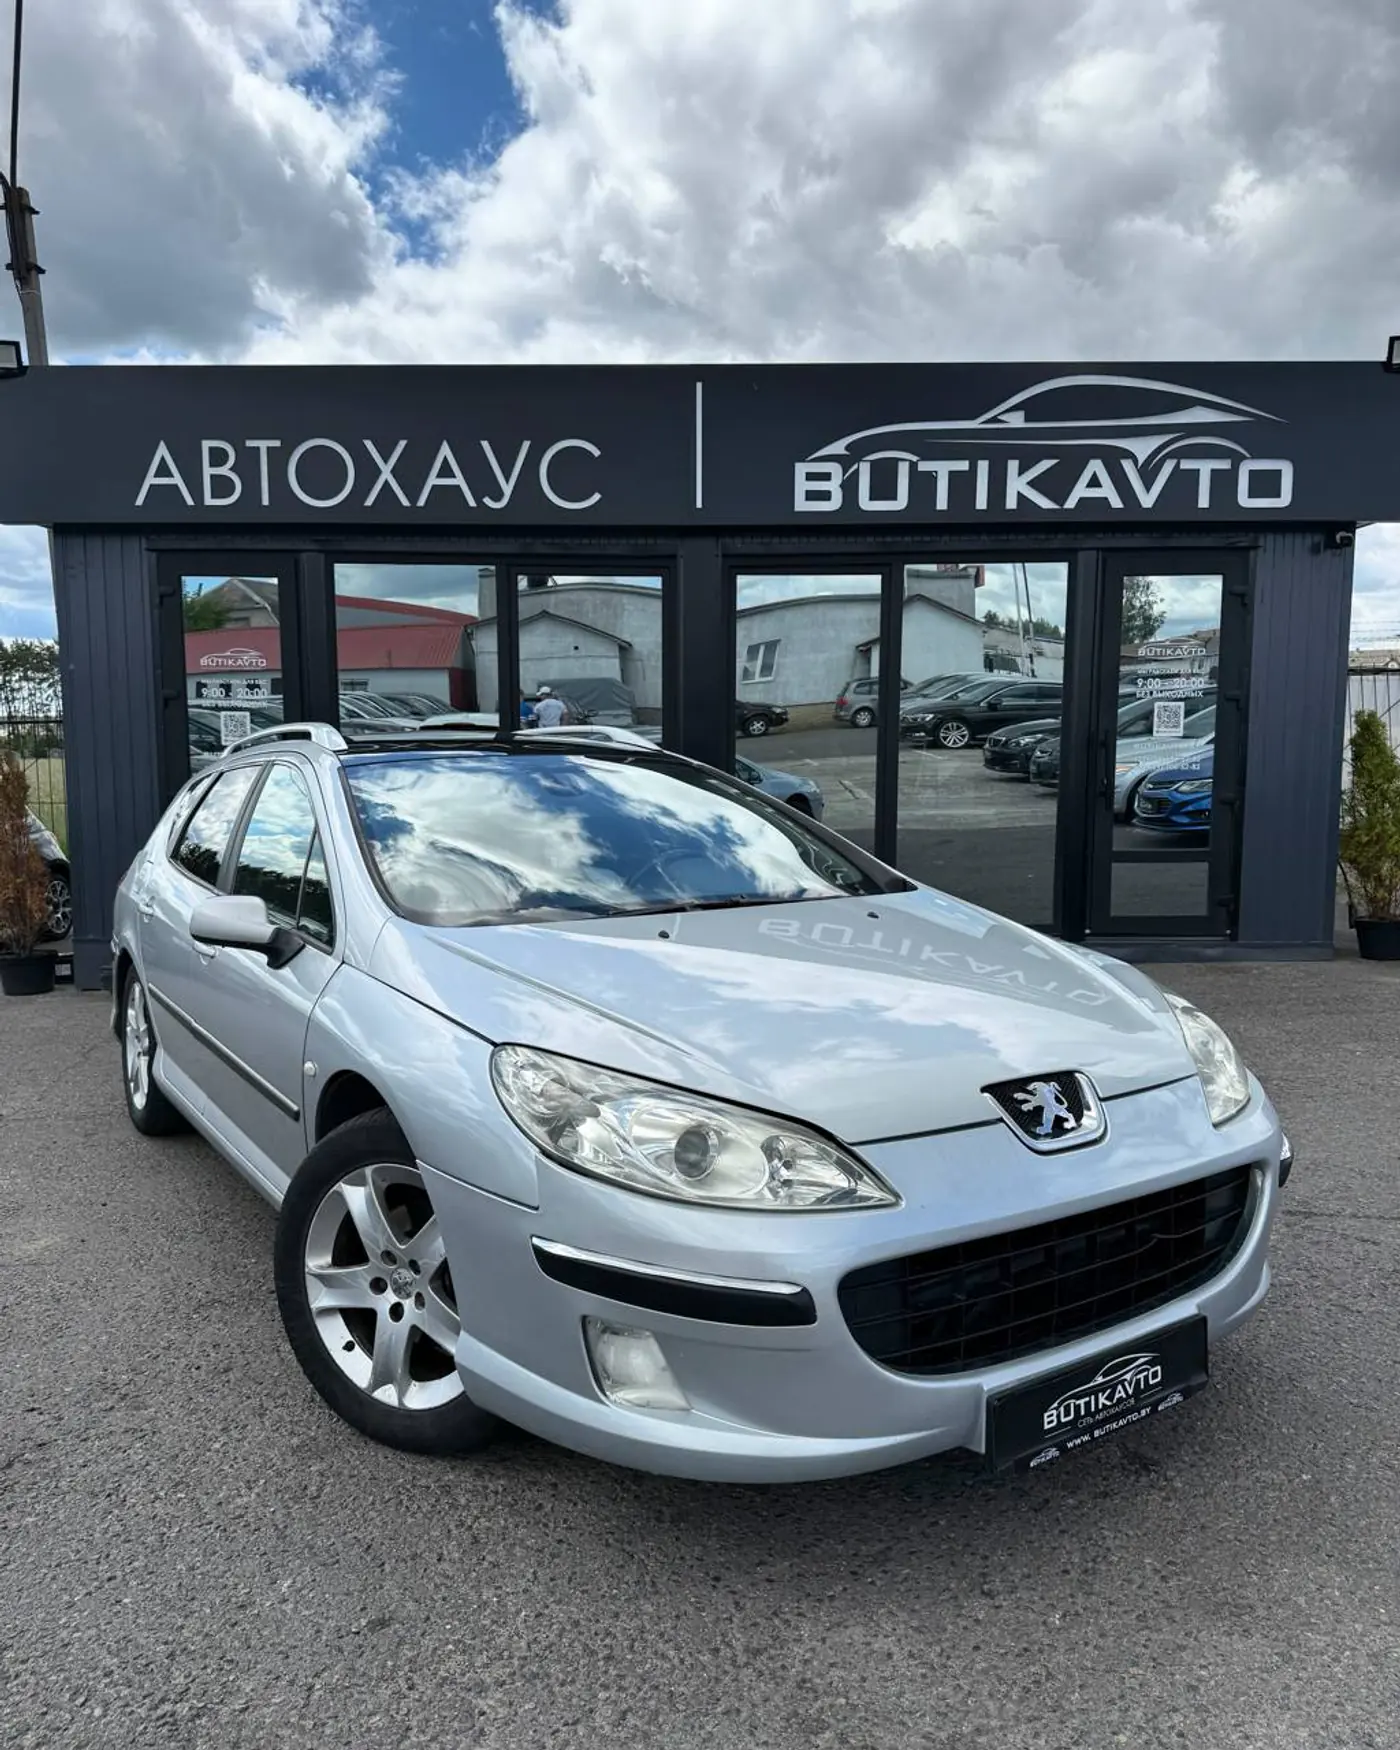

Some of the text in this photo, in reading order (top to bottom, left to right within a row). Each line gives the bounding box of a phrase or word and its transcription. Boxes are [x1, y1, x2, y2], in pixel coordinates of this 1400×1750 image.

[134, 437, 603, 511] АВТОХАУС
[794, 457, 1294, 513] BUTIKAVTO
[1137, 647, 1206, 657] BUTIKAVTO
[199, 657, 267, 667] BUTIKAVTO
[1136, 678, 1161, 688] 9:00
[236, 687, 268, 698] 20:00
[1043, 1365, 1162, 1430] BUTIKAVTO
